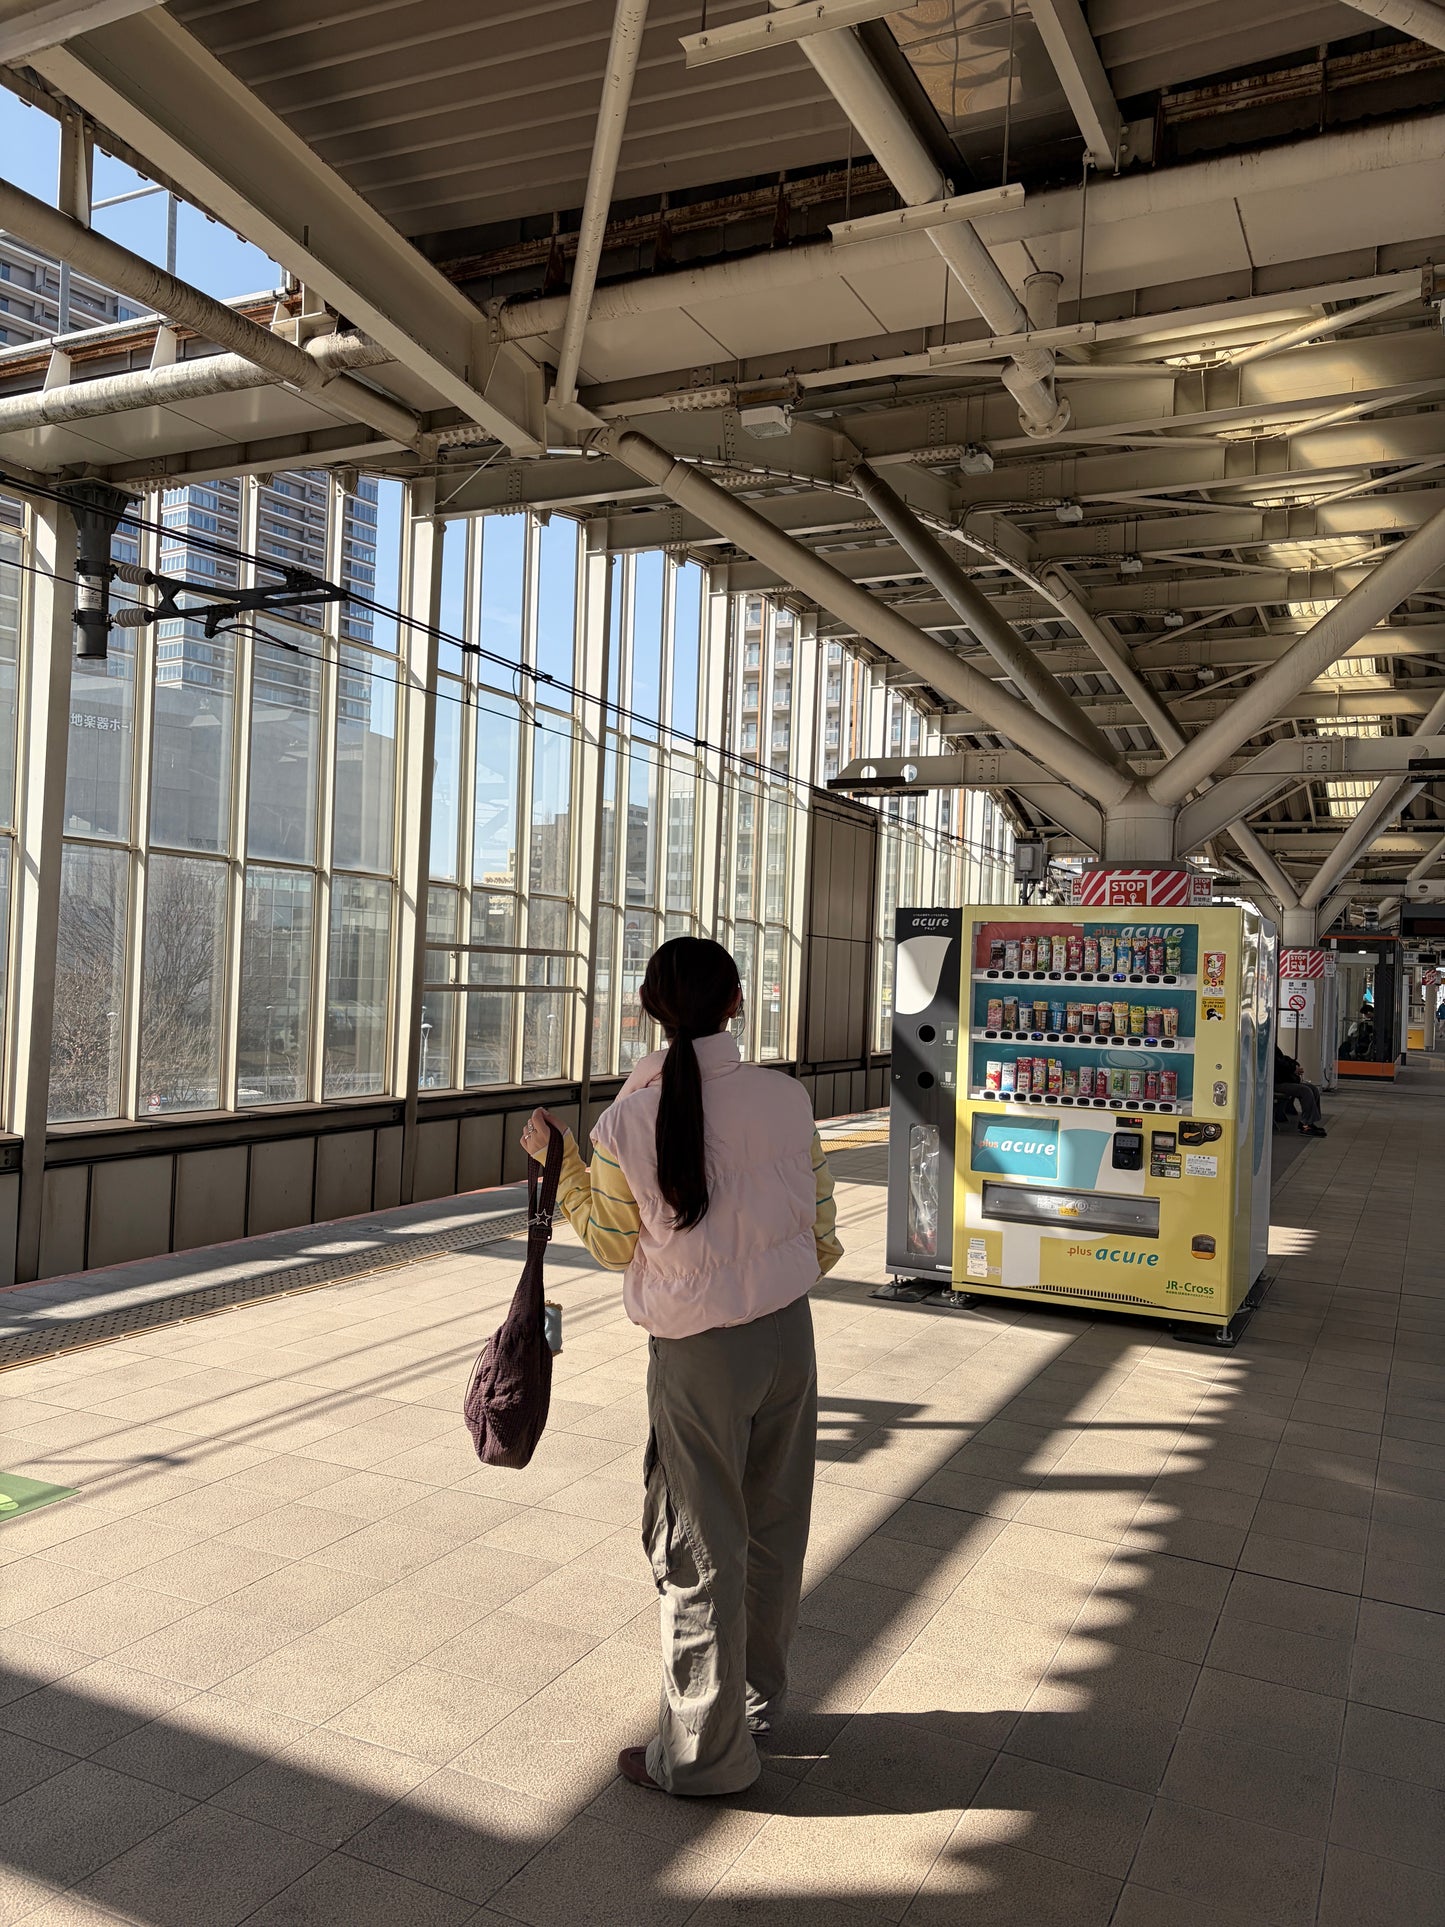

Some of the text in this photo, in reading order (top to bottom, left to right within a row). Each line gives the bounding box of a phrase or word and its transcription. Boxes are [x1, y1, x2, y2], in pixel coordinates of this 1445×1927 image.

[1111, 881, 1145, 892] STOP
[912, 918, 949, 927] acure
[1121, 926, 1185, 939] acure
[978, 1139, 1056, 1156] plus acure
[1095, 1248, 1159, 1266] acure
[1166, 1280, 1214, 1295] JR-Cross
